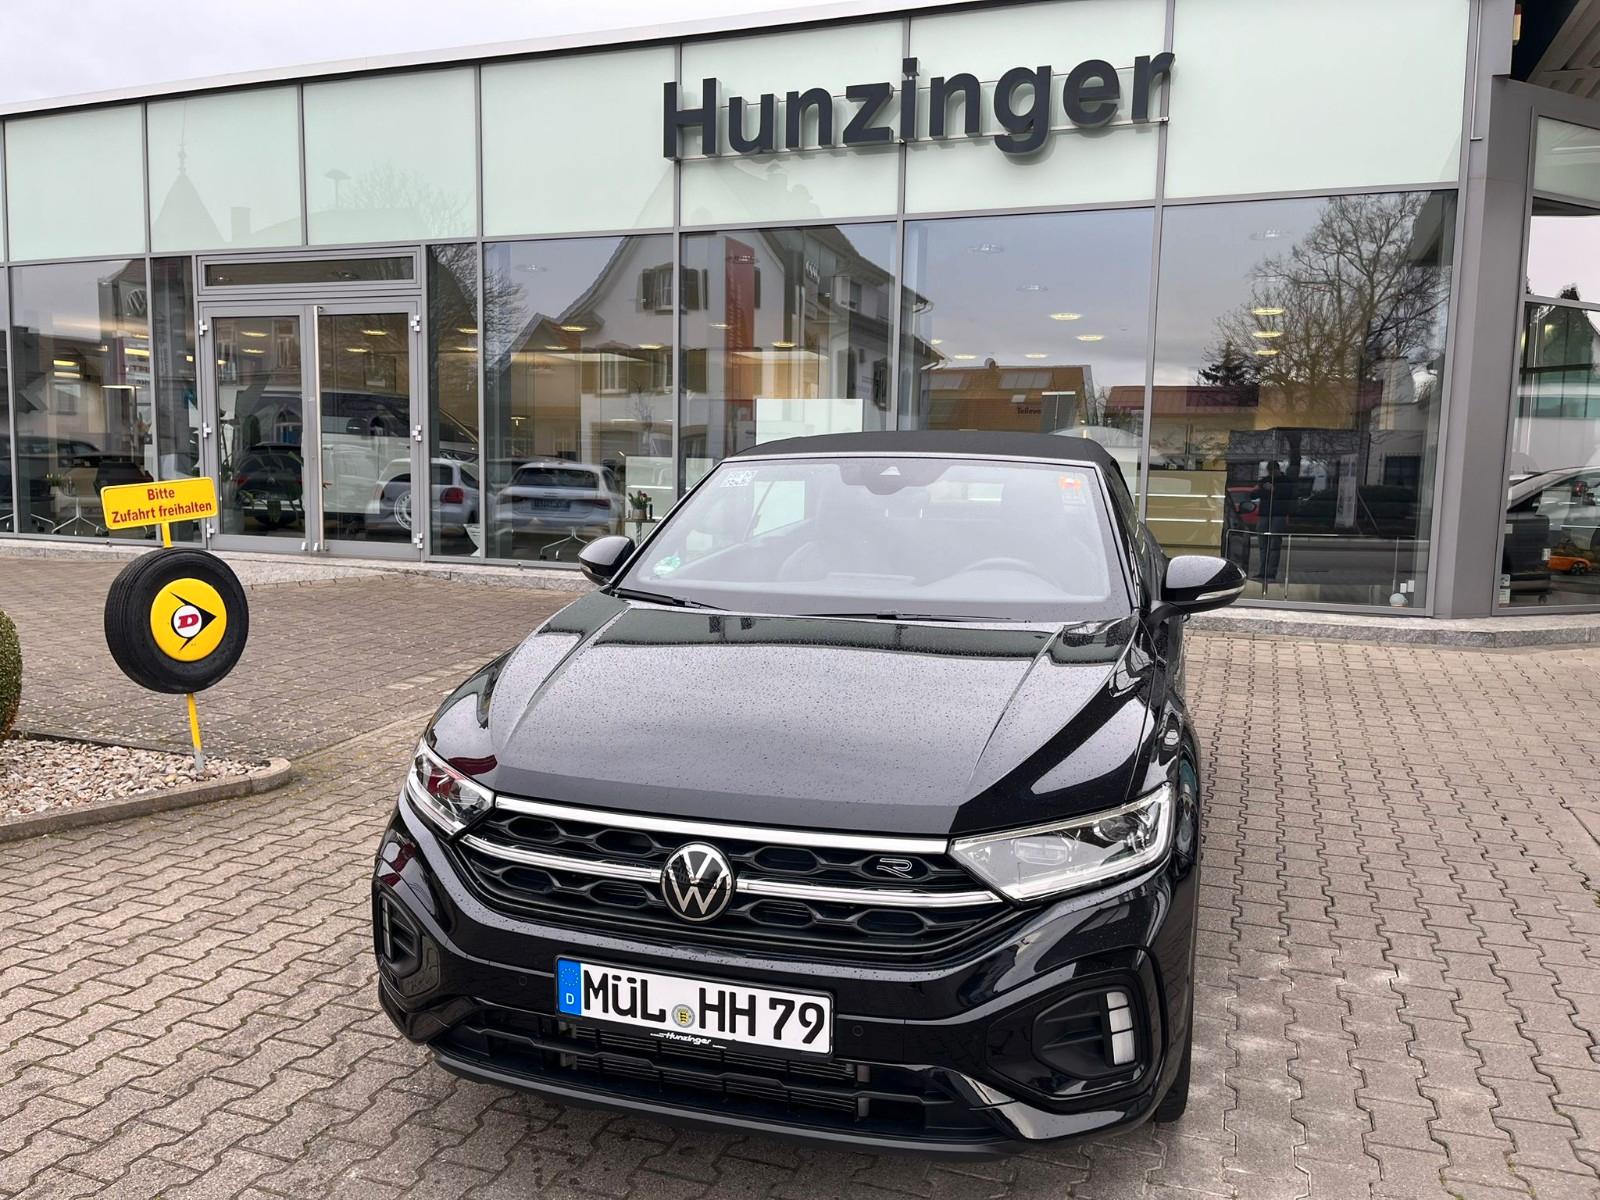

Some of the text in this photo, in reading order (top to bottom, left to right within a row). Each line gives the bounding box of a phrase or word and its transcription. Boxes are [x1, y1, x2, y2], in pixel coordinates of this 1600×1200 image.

[662, 51, 1175, 160] Hunzinger
[146, 487, 176, 501] Bitte
[111, 500, 213, 524] Zufahrt freihalten
[177, 614, 199, 630] D
[565, 991, 575, 1005] D
[583, 968, 826, 1045] MÜL HH 79
[664, 1032, 712, 1046] Hunzinger
